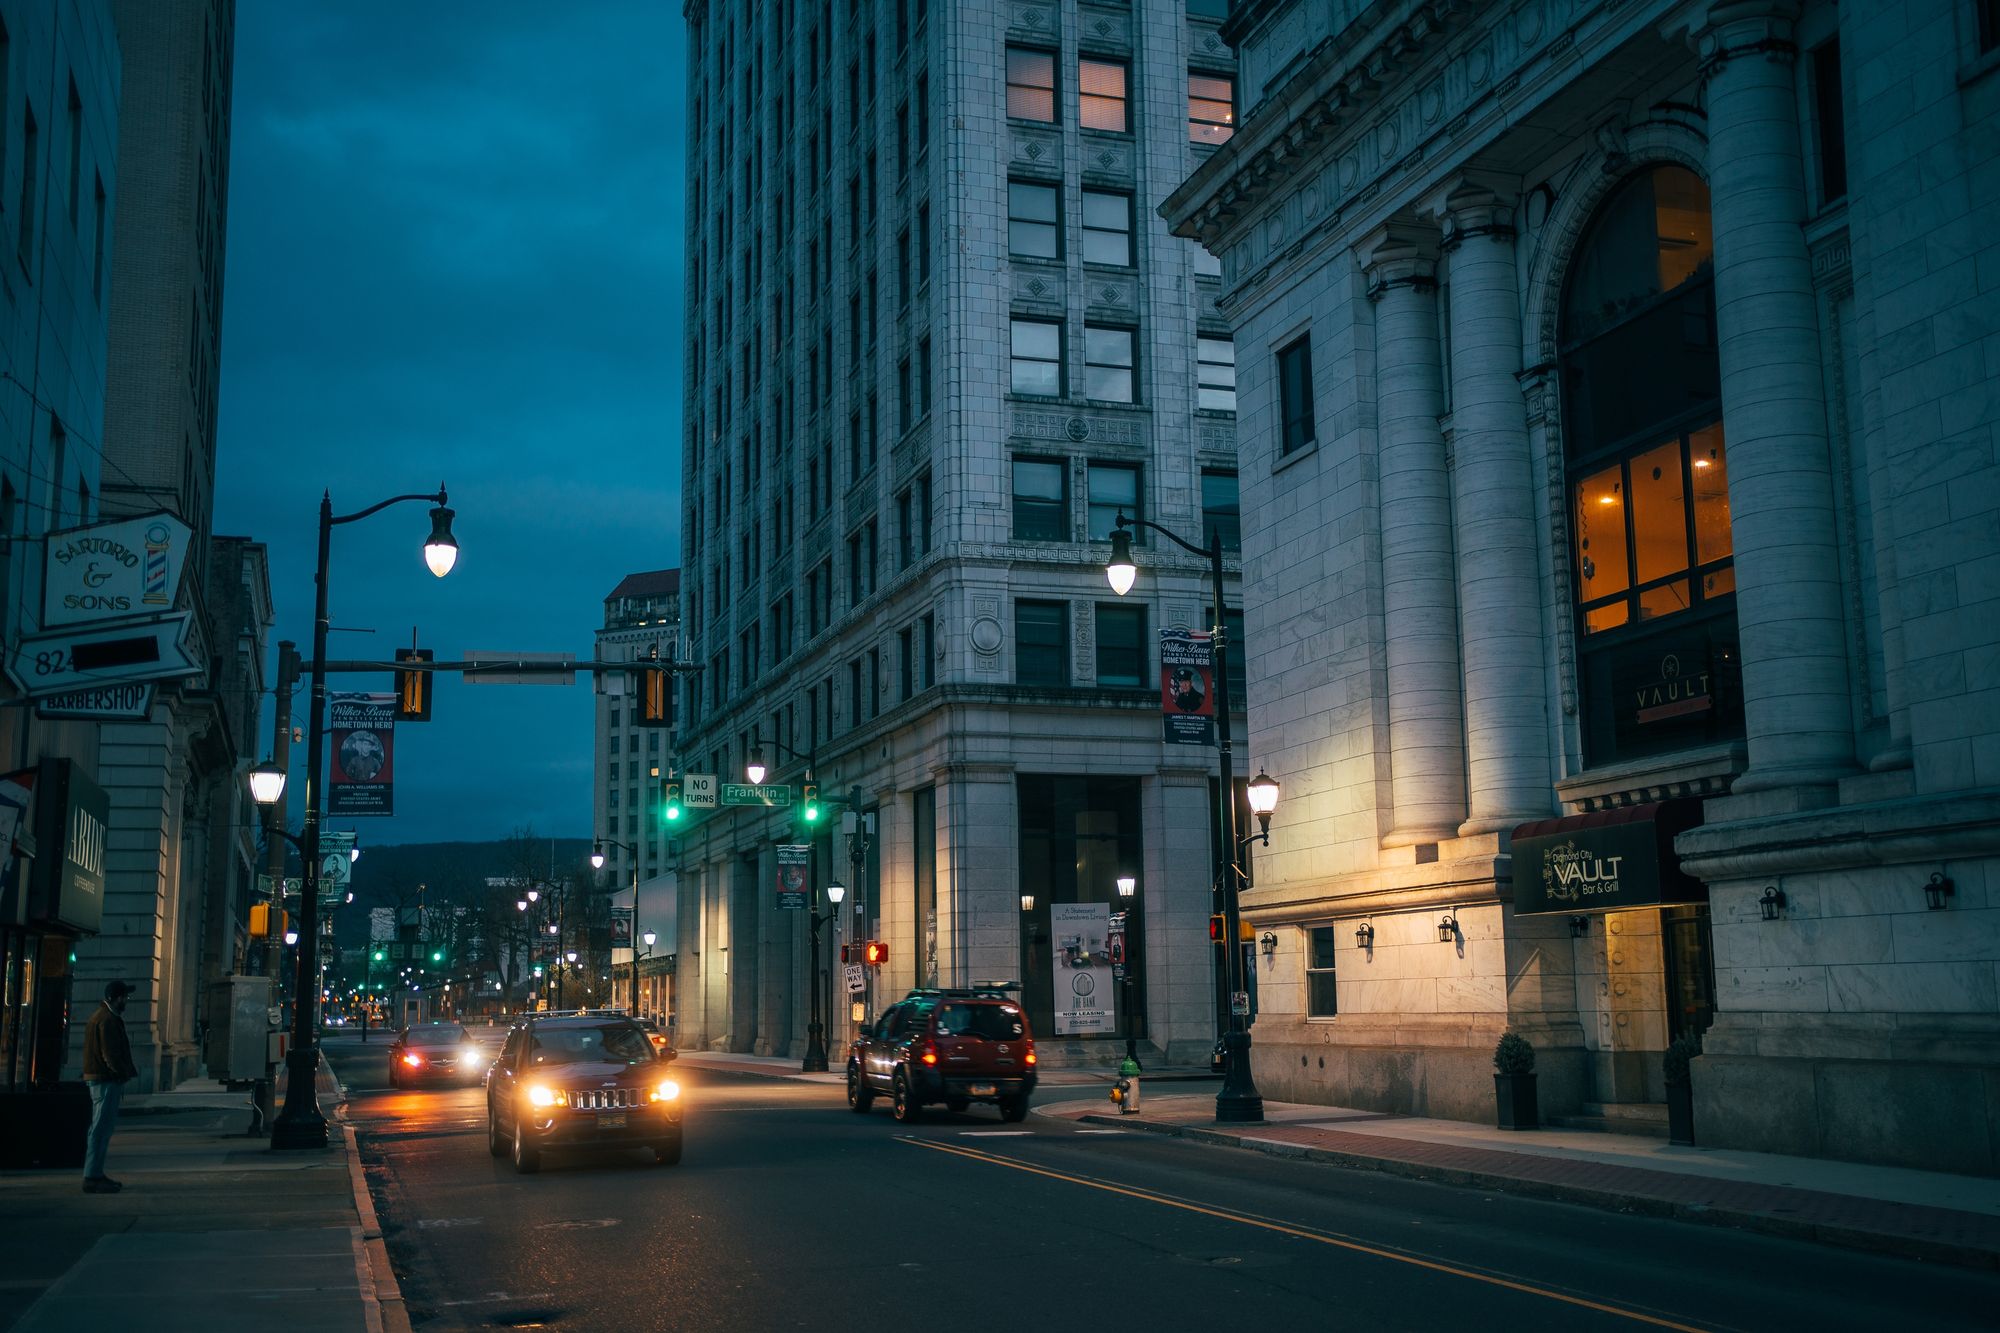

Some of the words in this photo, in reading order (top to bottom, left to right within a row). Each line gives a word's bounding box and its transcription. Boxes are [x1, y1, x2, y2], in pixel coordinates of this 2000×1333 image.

[55, 537, 139, 568] SARTORIO
[83, 562, 112, 588] &
[63, 594, 131, 611] SONS
[1161, 641, 1211, 654] Wilkes-Barre
[1163, 657, 1195, 665] HOMETOWN
[1196, 657, 1210, 666] HERO
[47, 684, 145, 711] BARBERSHOP
[1636, 674, 1709, 708] VAULT
[331, 704, 395, 717] Wilkes-Barre
[332, 721, 373, 729] HOMETOWN
[374, 721, 393, 729] HERO
[692, 779, 708, 790] NO
[686, 794, 714, 803] TURNS
[726, 786, 777, 798] Franklin
[67, 803, 106, 878] ABIDE
[1552, 851, 1580, 863] Diamond
[1580, 850, 1593, 861] City
[1553, 856, 1622, 885] VAULT
[1582, 884, 1596, 895] Bar
[1597, 883, 1604, 893] &
[1604, 880, 1619, 893] Grill
[846, 966, 861, 975] ONE
[847, 974, 862, 983] WAY
[1082, 996, 1096, 1008] BANK
